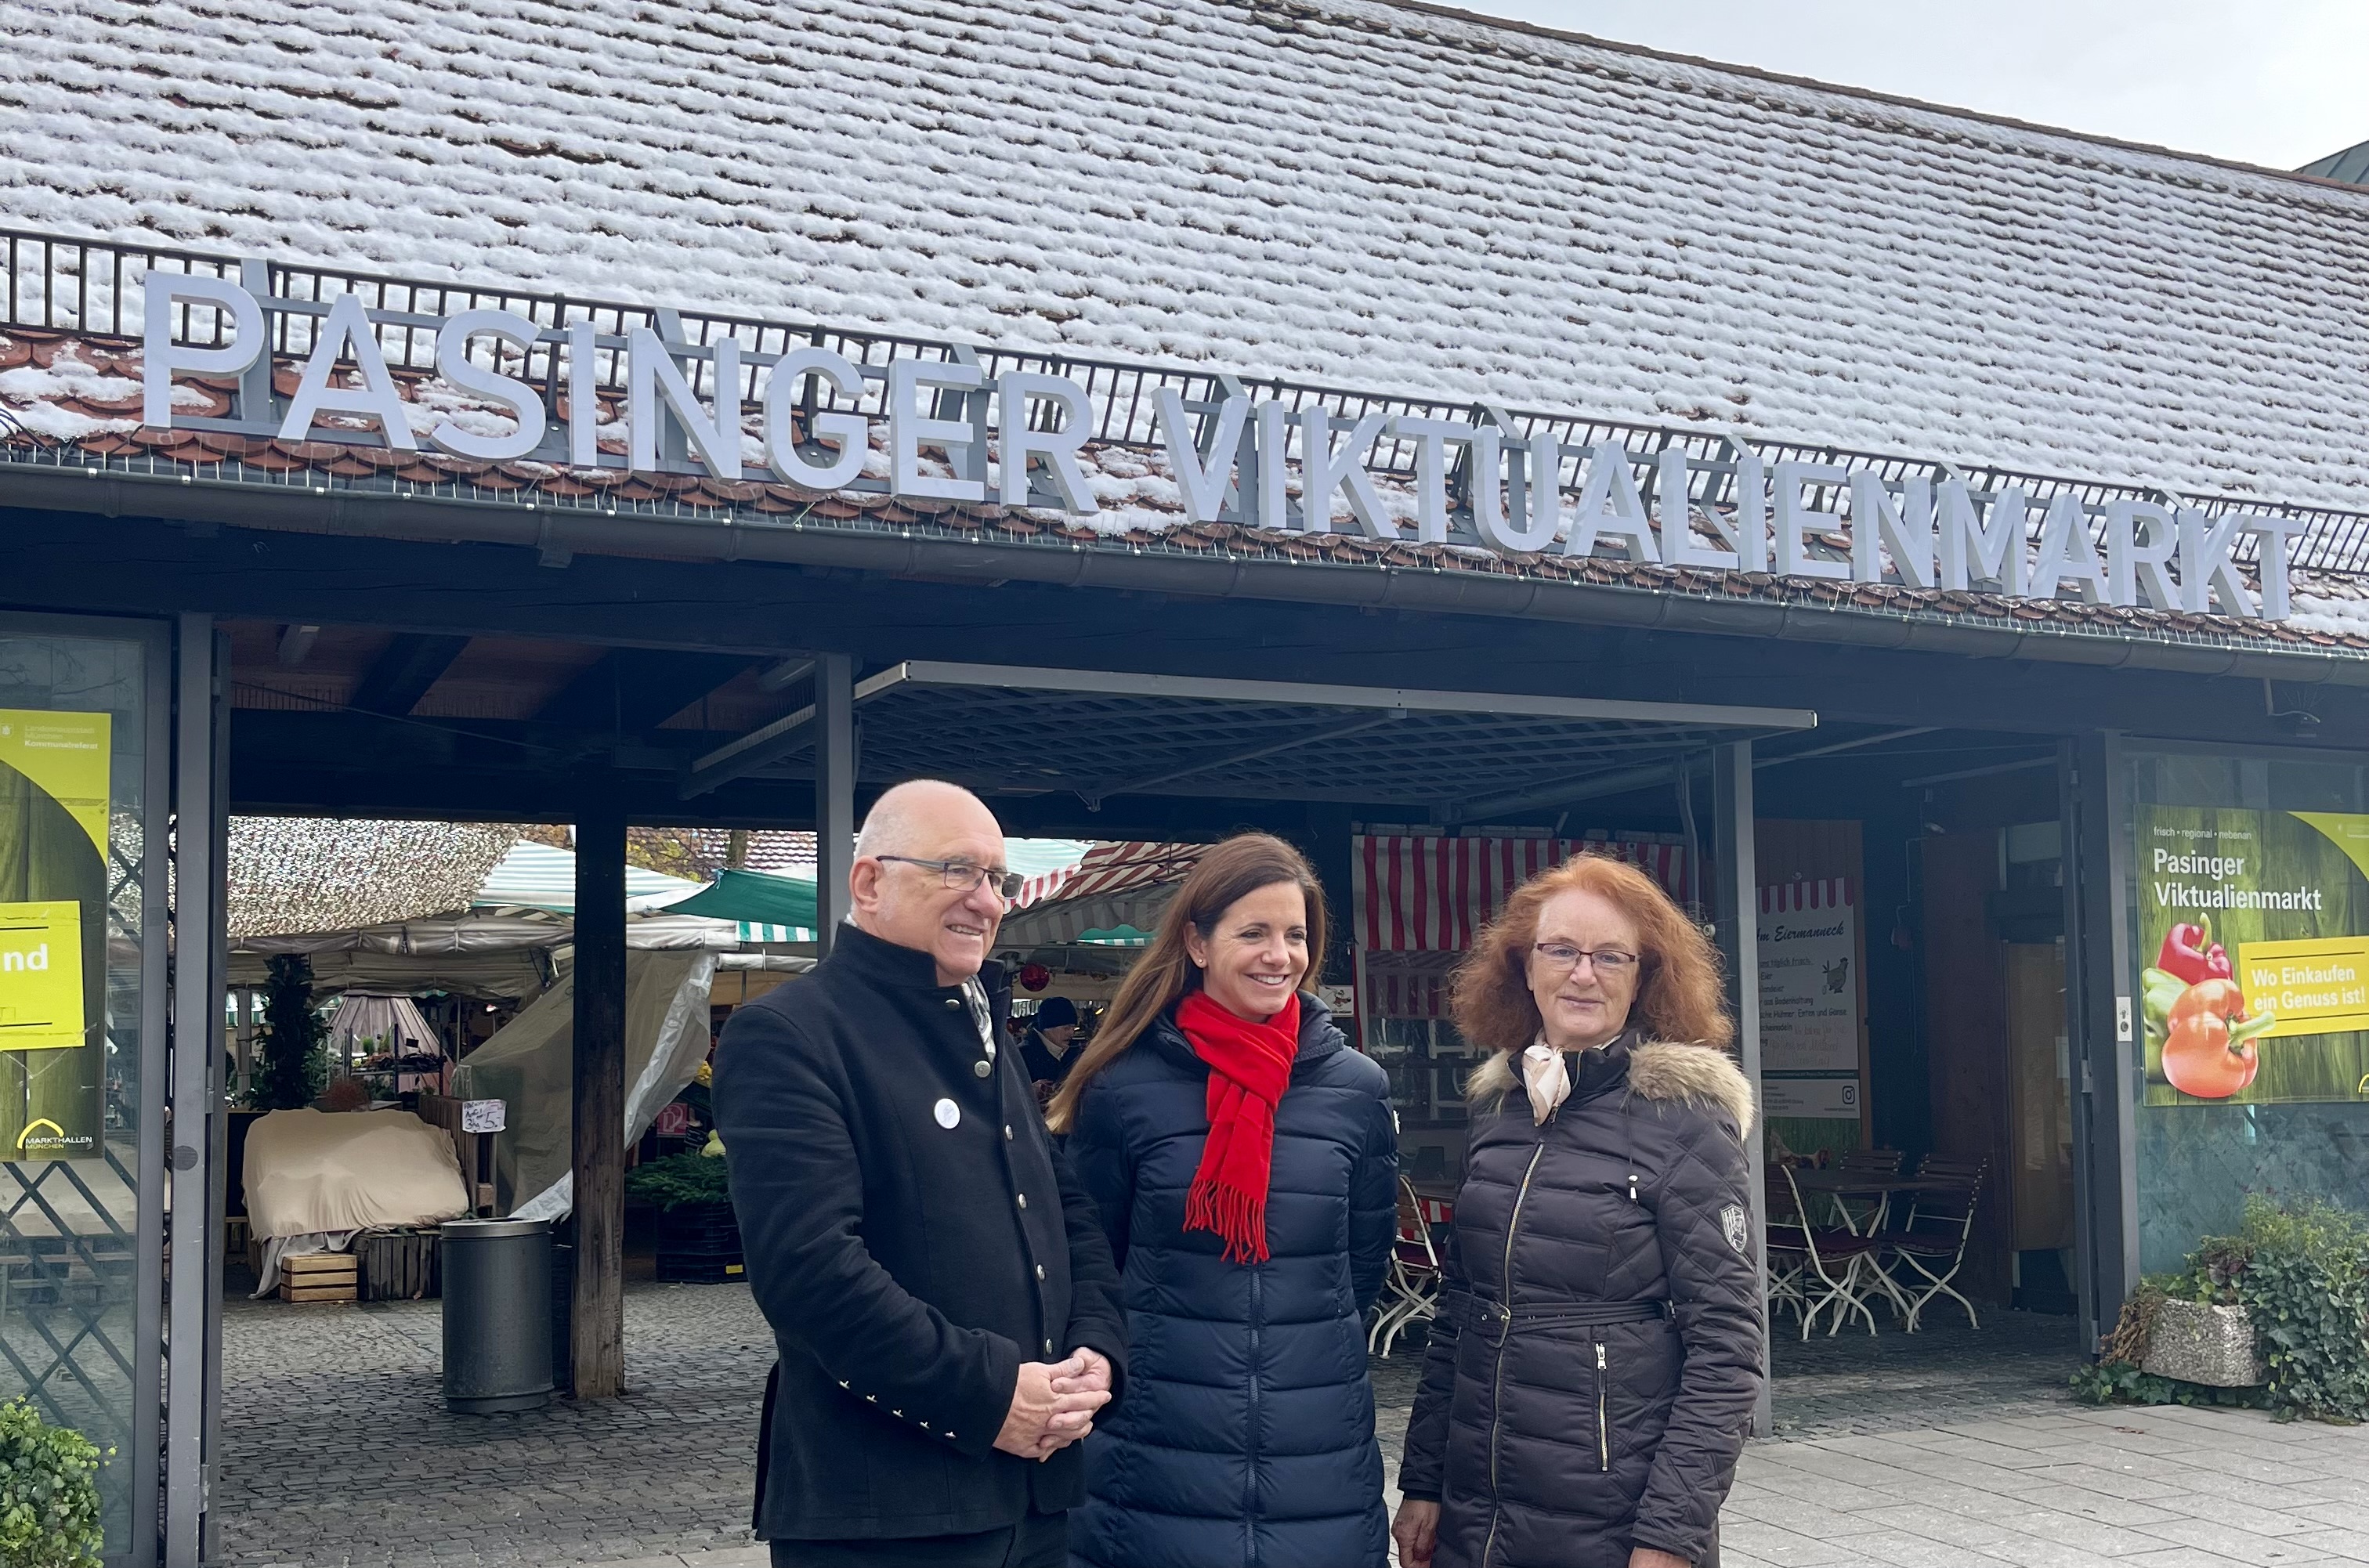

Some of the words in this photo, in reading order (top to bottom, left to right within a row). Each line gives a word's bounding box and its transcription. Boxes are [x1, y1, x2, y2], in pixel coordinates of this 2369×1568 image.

[143, 269, 1099, 515] PASINGER
[1150, 386, 2306, 622] VIKTUALIENMARKT
[2154, 826, 2175, 836] frisch
[2182, 829, 2212, 840] regional
[2219, 830, 2251, 840] nebenan
[2154, 848, 2244, 880] Pasinger
[2154, 882, 2321, 910] Viktualienmarkt
[1774, 920, 1844, 941] Eiermanneck
[3, 943, 49, 972] nd
[2251, 968, 2277, 987] Wo
[2281, 964, 2355, 985] Einkaufen
[2254, 993, 2277, 1010] ein
[2281, 990, 2338, 1010] Genuss
[2342, 986, 2366, 1005] ist!
